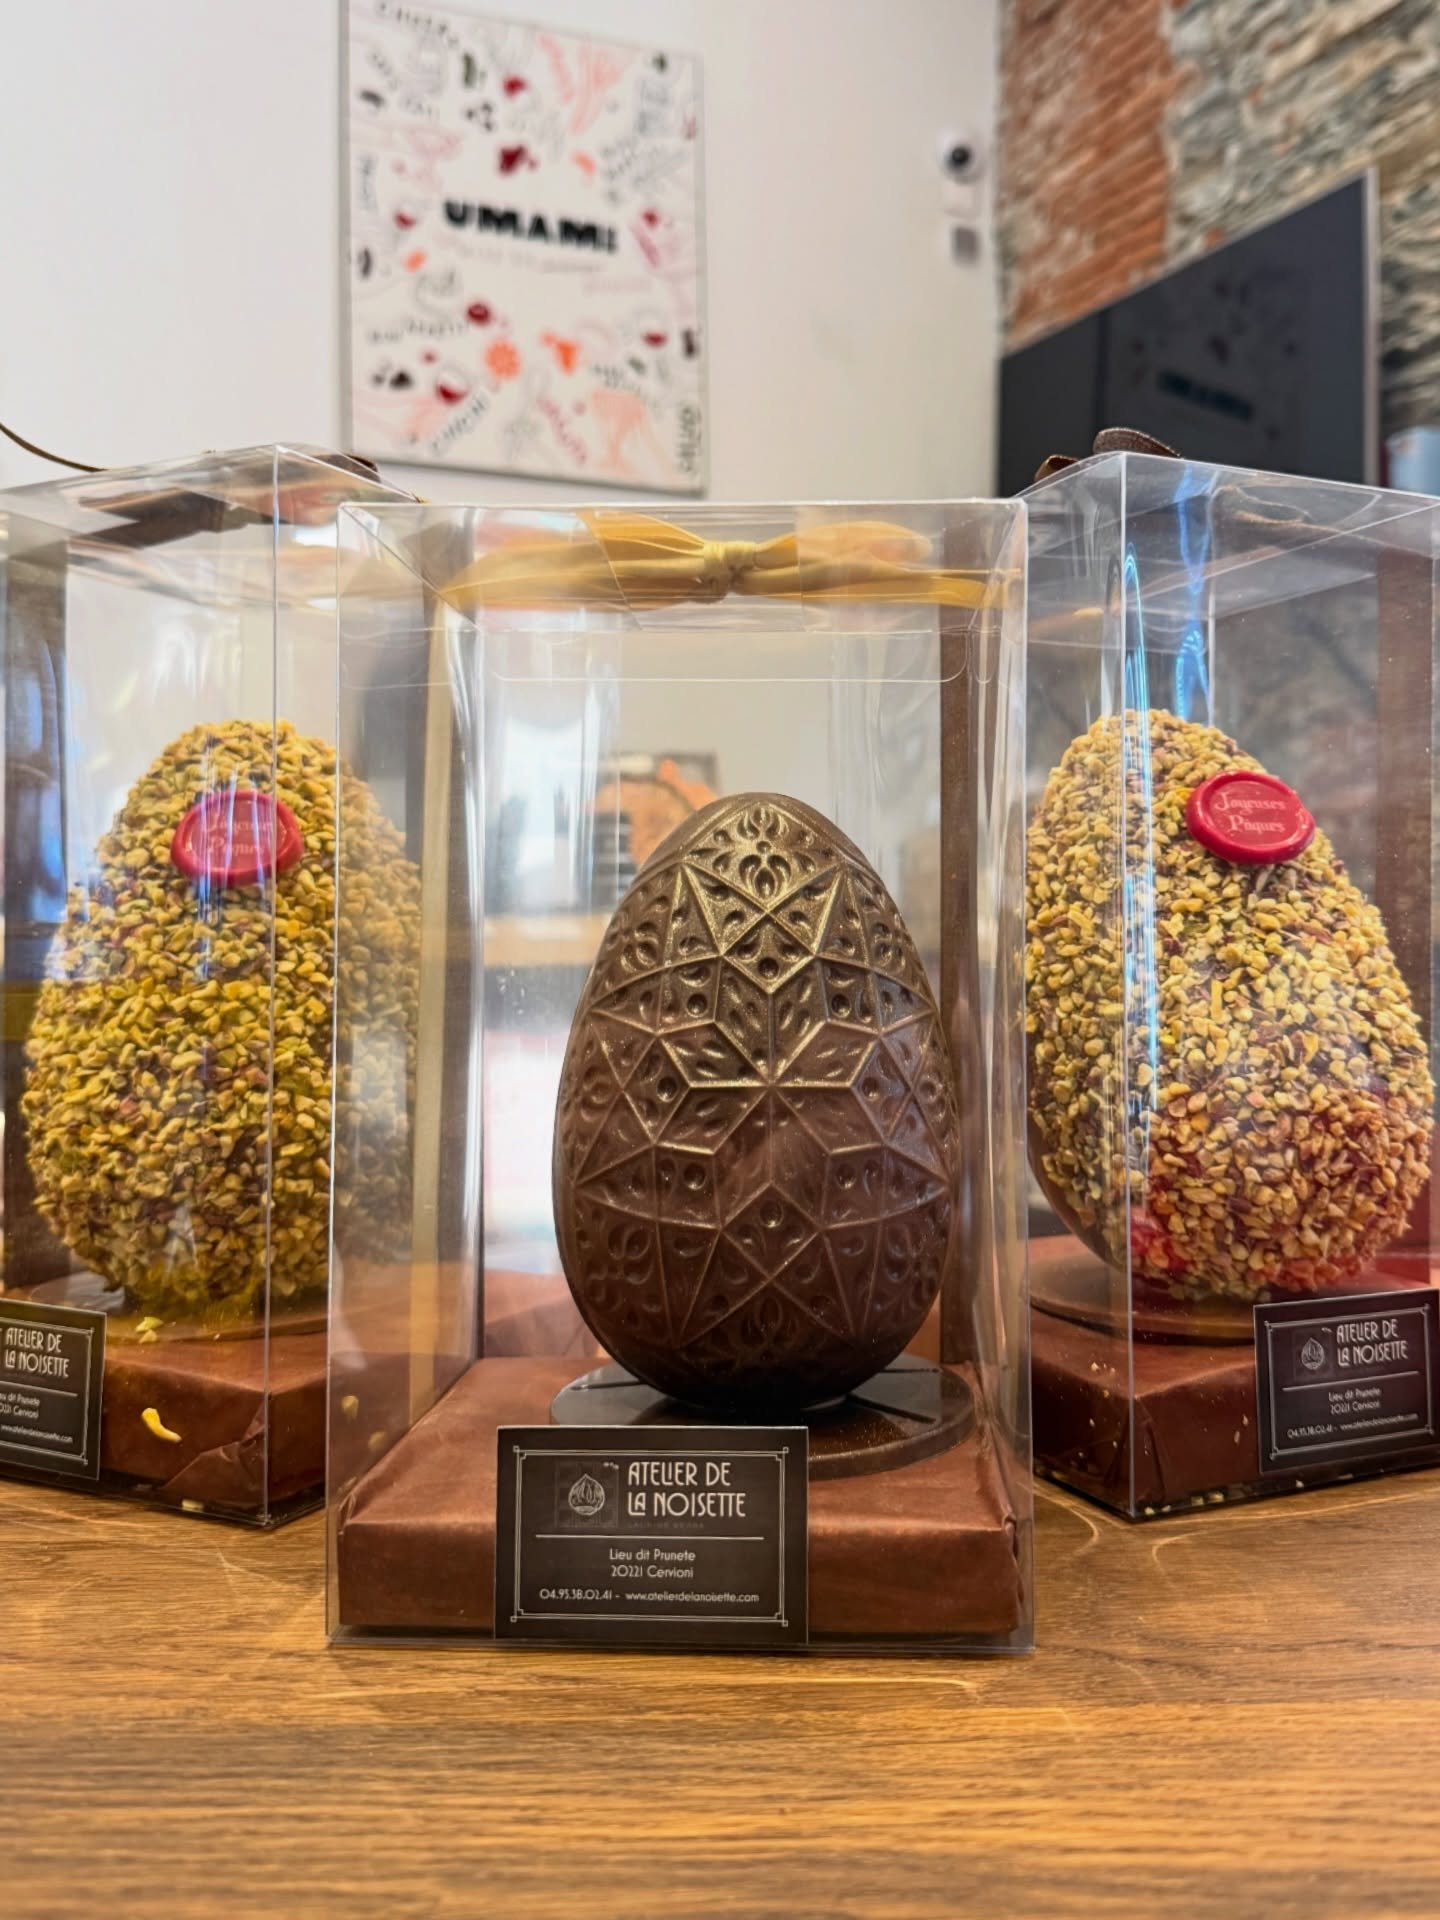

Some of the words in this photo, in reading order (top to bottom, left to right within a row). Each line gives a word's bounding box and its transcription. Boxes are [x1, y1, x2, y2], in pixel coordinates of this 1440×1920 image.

[443, 199, 617, 254] UMAMI
[6, 1327, 44, 1350] ATELIER
[47, 1332, 62, 1353] DE
[1337, 1321, 1380, 1344] ATELIER
[1382, 1318, 1399, 1339] DE
[5, 1349, 16, 1369] LA
[19, 1351, 70, 1378] NOISETTE
[1337, 1347, 1350, 1367] LA
[1353, 1340, 1408, 1365] NOISETTE
[628, 1461, 698, 1486] ATELIER
[706, 1461, 731, 1486] DE
[628, 1491, 646, 1516] LA
[654, 1491, 746, 1517] NOISETTE
[609, 1548, 632, 1561] Lieu
[636, 1548, 650, 1561] dit
[654, 1548, 696, 1562] Prunete
[611, 1564, 643, 1578] 20221
[647, 1564, 694, 1579] Cervioni
[539, 1587, 613, 1600] 04.95.38.02.41
